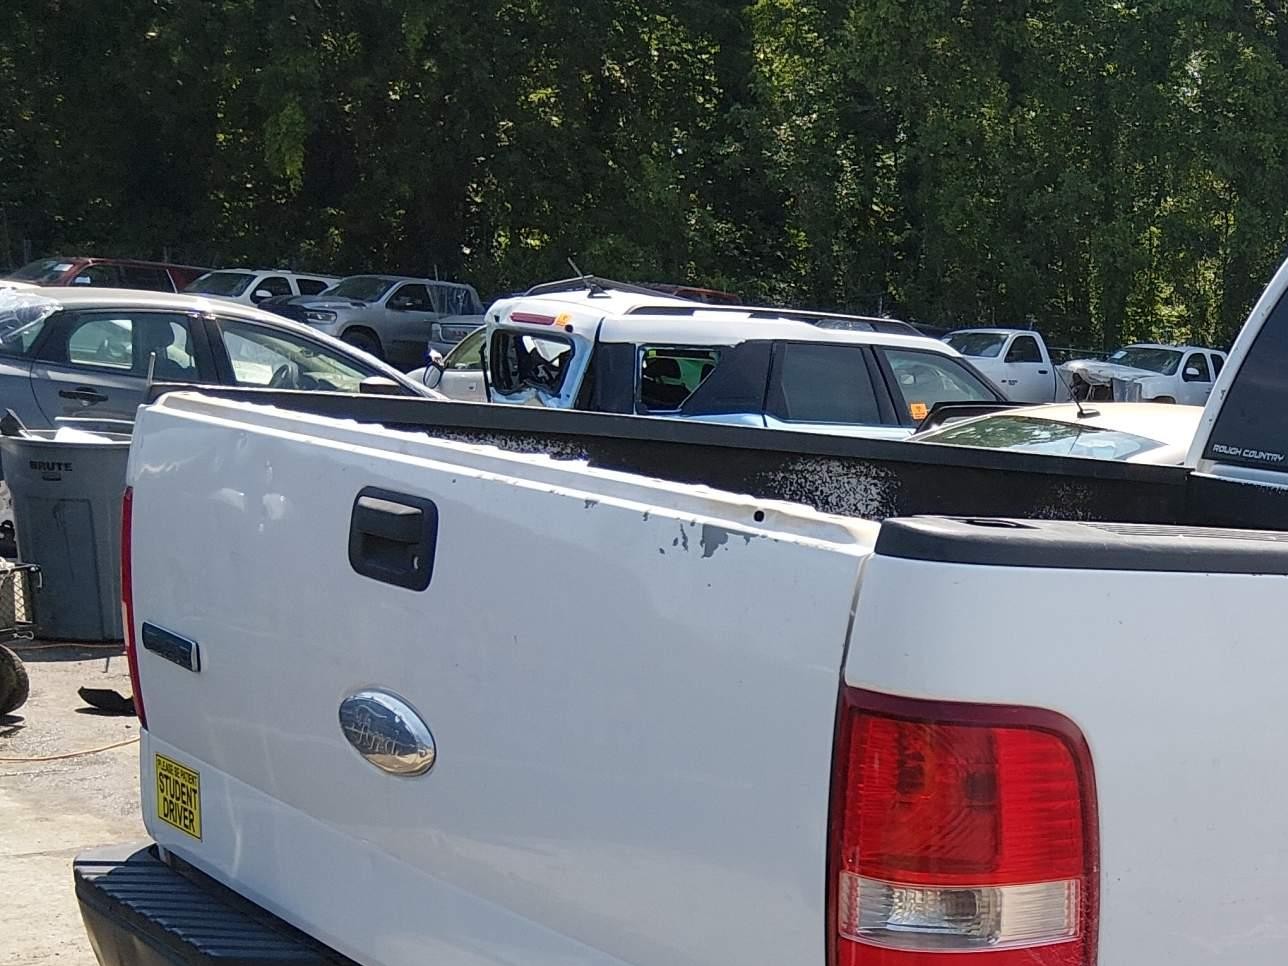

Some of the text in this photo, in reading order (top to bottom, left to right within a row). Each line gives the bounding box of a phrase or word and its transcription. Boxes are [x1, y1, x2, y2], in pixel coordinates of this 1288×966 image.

[29, 460, 73, 472] BRUTE
[1212, 444, 1285, 461] ROUGH COUNTRY
[159, 771, 198, 811] STUDENT
[162, 796, 196, 833] DRIVER
